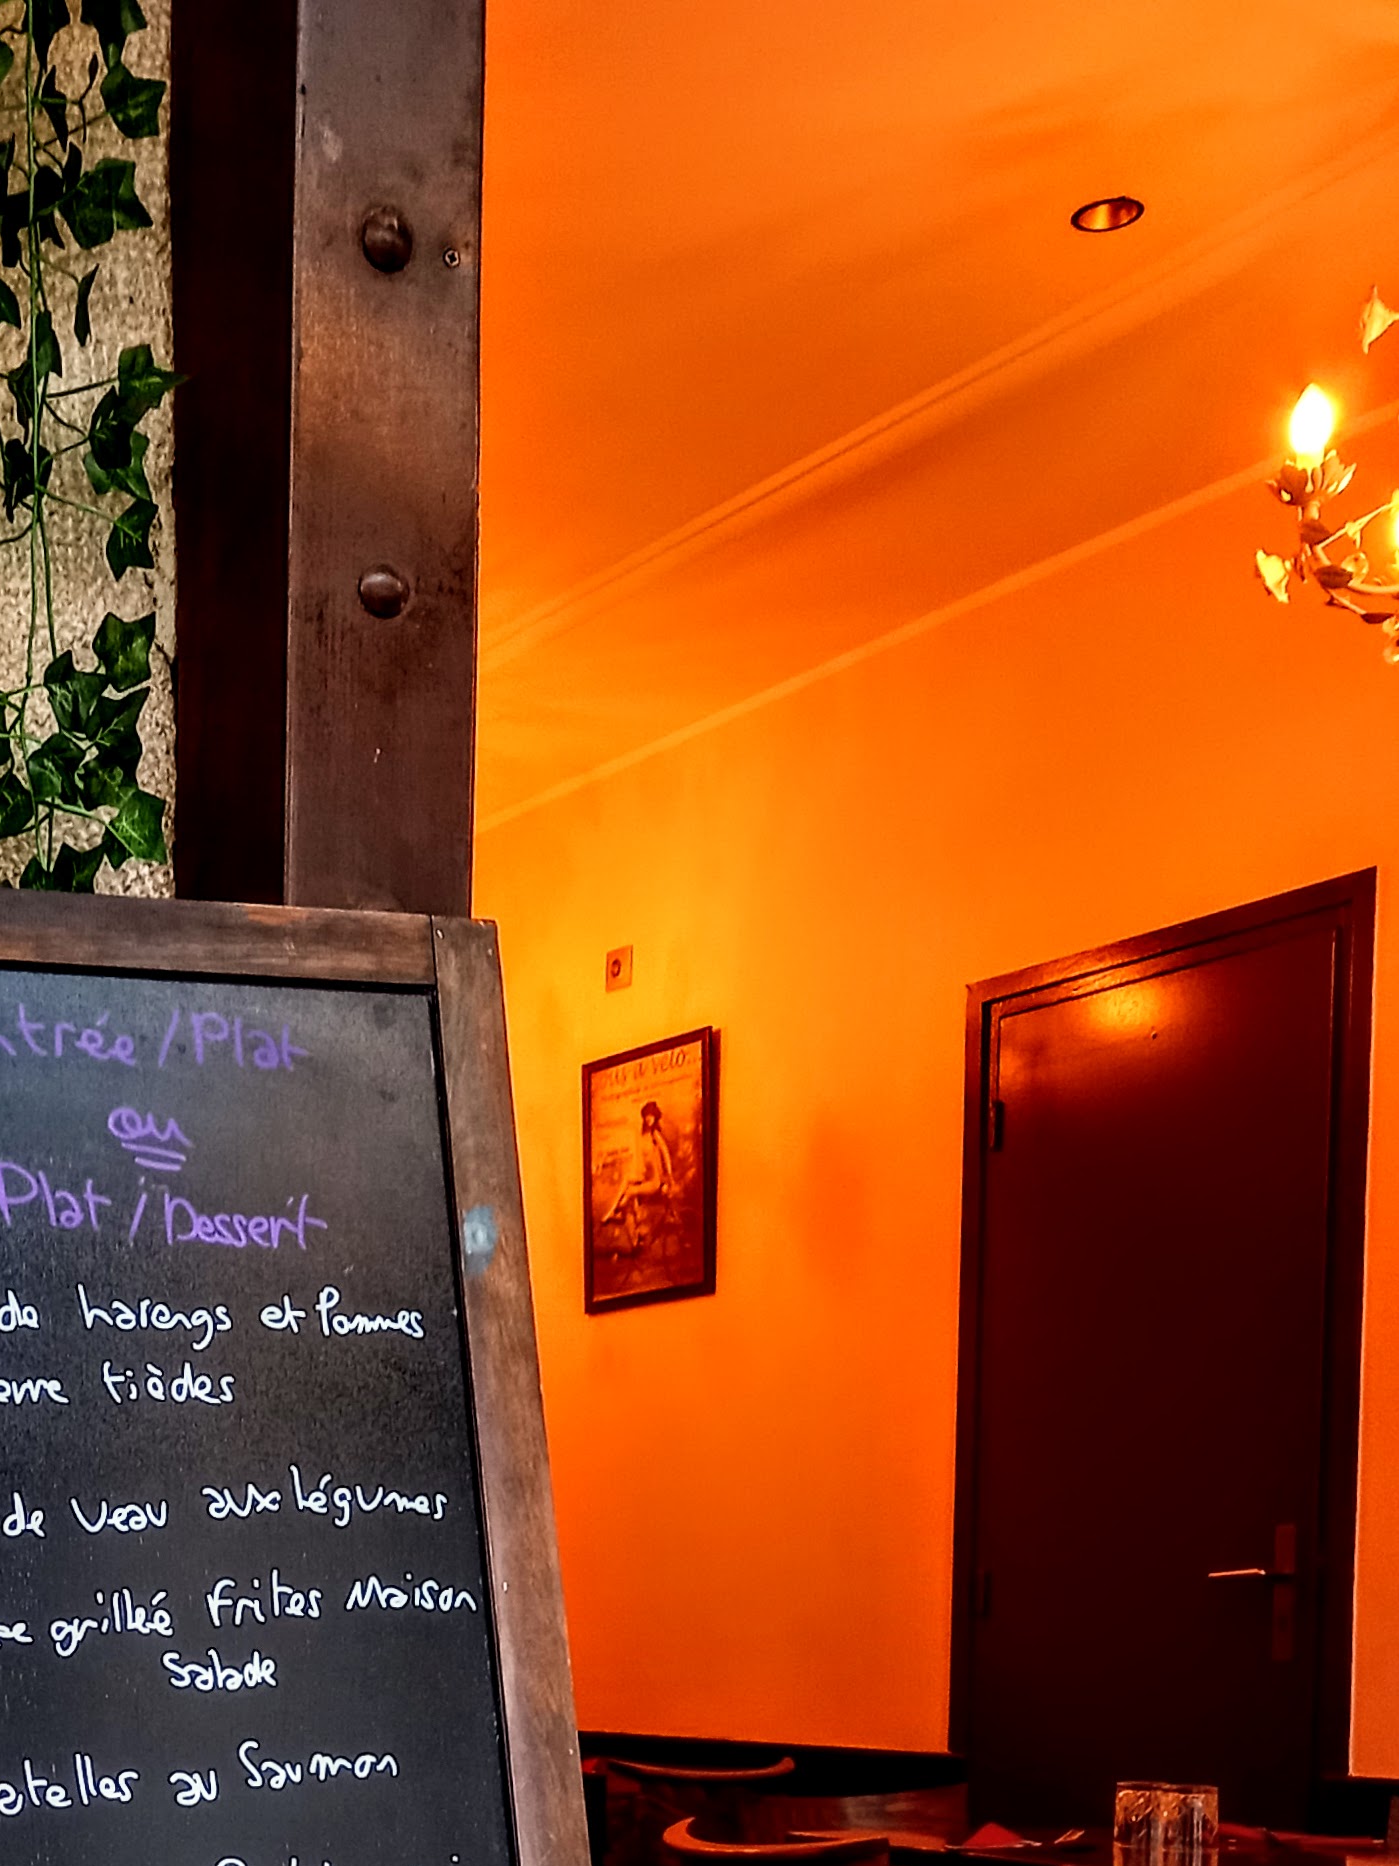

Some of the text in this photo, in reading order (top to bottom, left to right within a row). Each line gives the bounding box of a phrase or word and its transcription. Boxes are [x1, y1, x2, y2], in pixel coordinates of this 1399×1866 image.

[76, 1283, 233, 1350] harengs
[260, 1294, 306, 1333] et
[103, 1361, 236, 1403] tièdes
[2, 1491, 46, 1538] de
[202, 1484, 283, 1519] aux
[170, 1769, 219, 1806] au
[239, 1740, 398, 1789] Saumon
